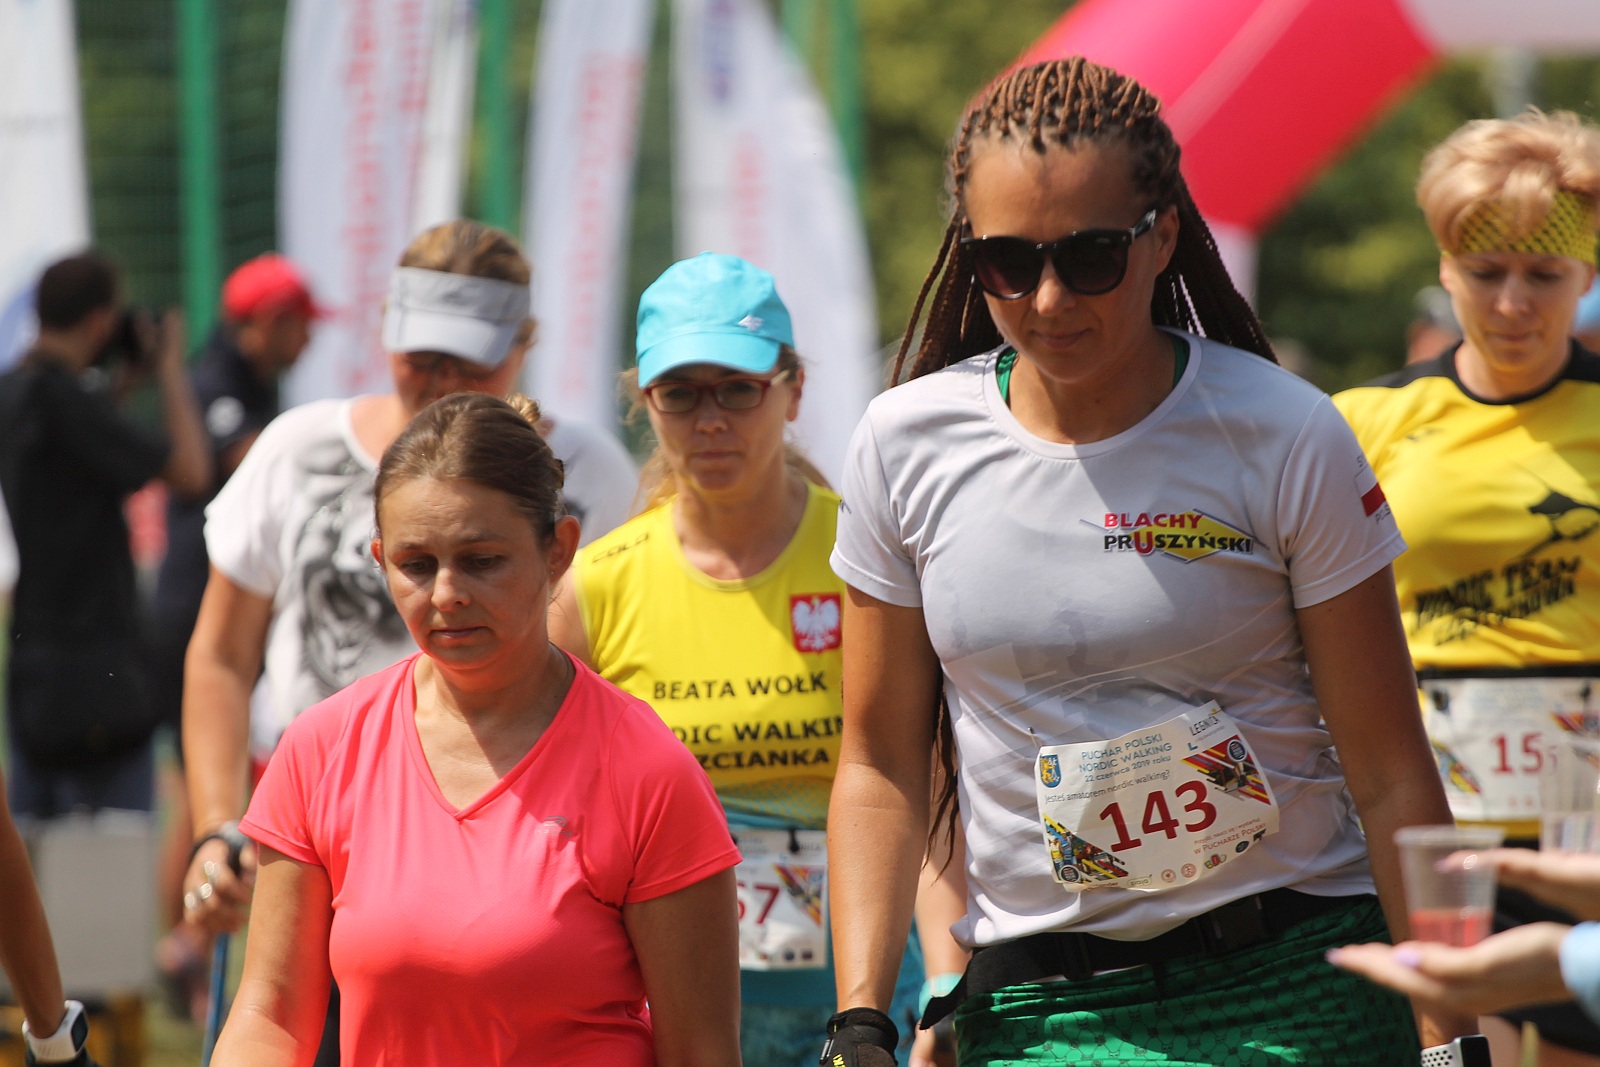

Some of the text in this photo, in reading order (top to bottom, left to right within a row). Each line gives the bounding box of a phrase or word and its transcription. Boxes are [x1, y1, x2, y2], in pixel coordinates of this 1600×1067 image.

[1104, 513, 1204, 528] BLACHY
[1104, 531, 1251, 554] PRUSZYŃSKI
[653, 671, 828, 700] BEATA WOŁK
[1079, 742, 1172, 772] NORDIC WALKING
[1081, 733, 1163, 760] PUCHAR POLSKI
[1085, 755, 1172, 783] 22 czerwca 2019 roku
[1067, 788, 1106, 802] amatorem
[1107, 779, 1135, 794] nordic
[1136, 769, 1170, 785] walking?
[1099, 780, 1217, 852] 143
